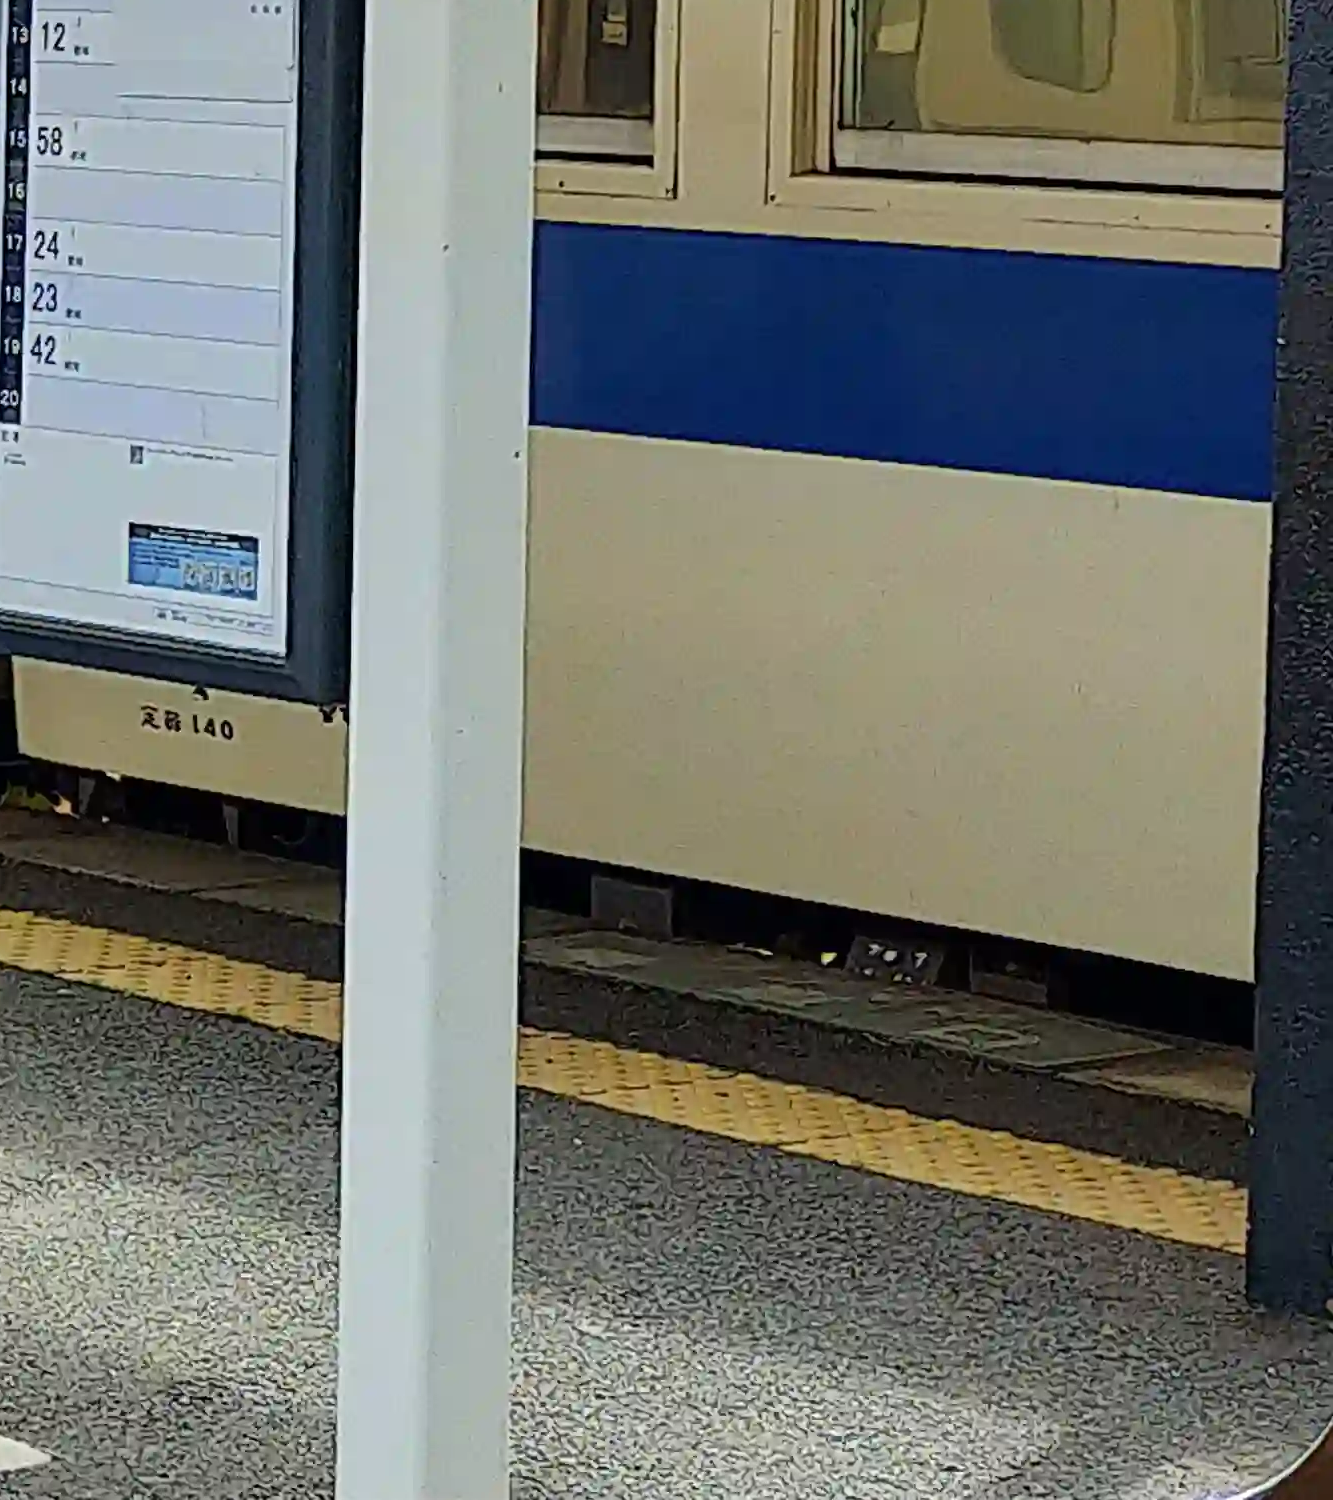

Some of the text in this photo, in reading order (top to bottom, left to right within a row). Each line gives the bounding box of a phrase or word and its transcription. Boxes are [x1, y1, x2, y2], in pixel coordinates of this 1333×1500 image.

[12, 21, 66, 52] 13 12
[10, 78, 28, 95] 14
[9, 130, 27, 148] 15
[36, 126, 63, 156] 58
[8, 182, 25, 200] 16
[5, 234, 23, 250] 17
[33, 230, 59, 261] 24
[5, 286, 21, 303] 18
[31, 282, 58, 313] 23
[3, 334, 57, 365] 19 42
[0, 389, 19, 406] 20
[192, 714, 234, 741] 140
